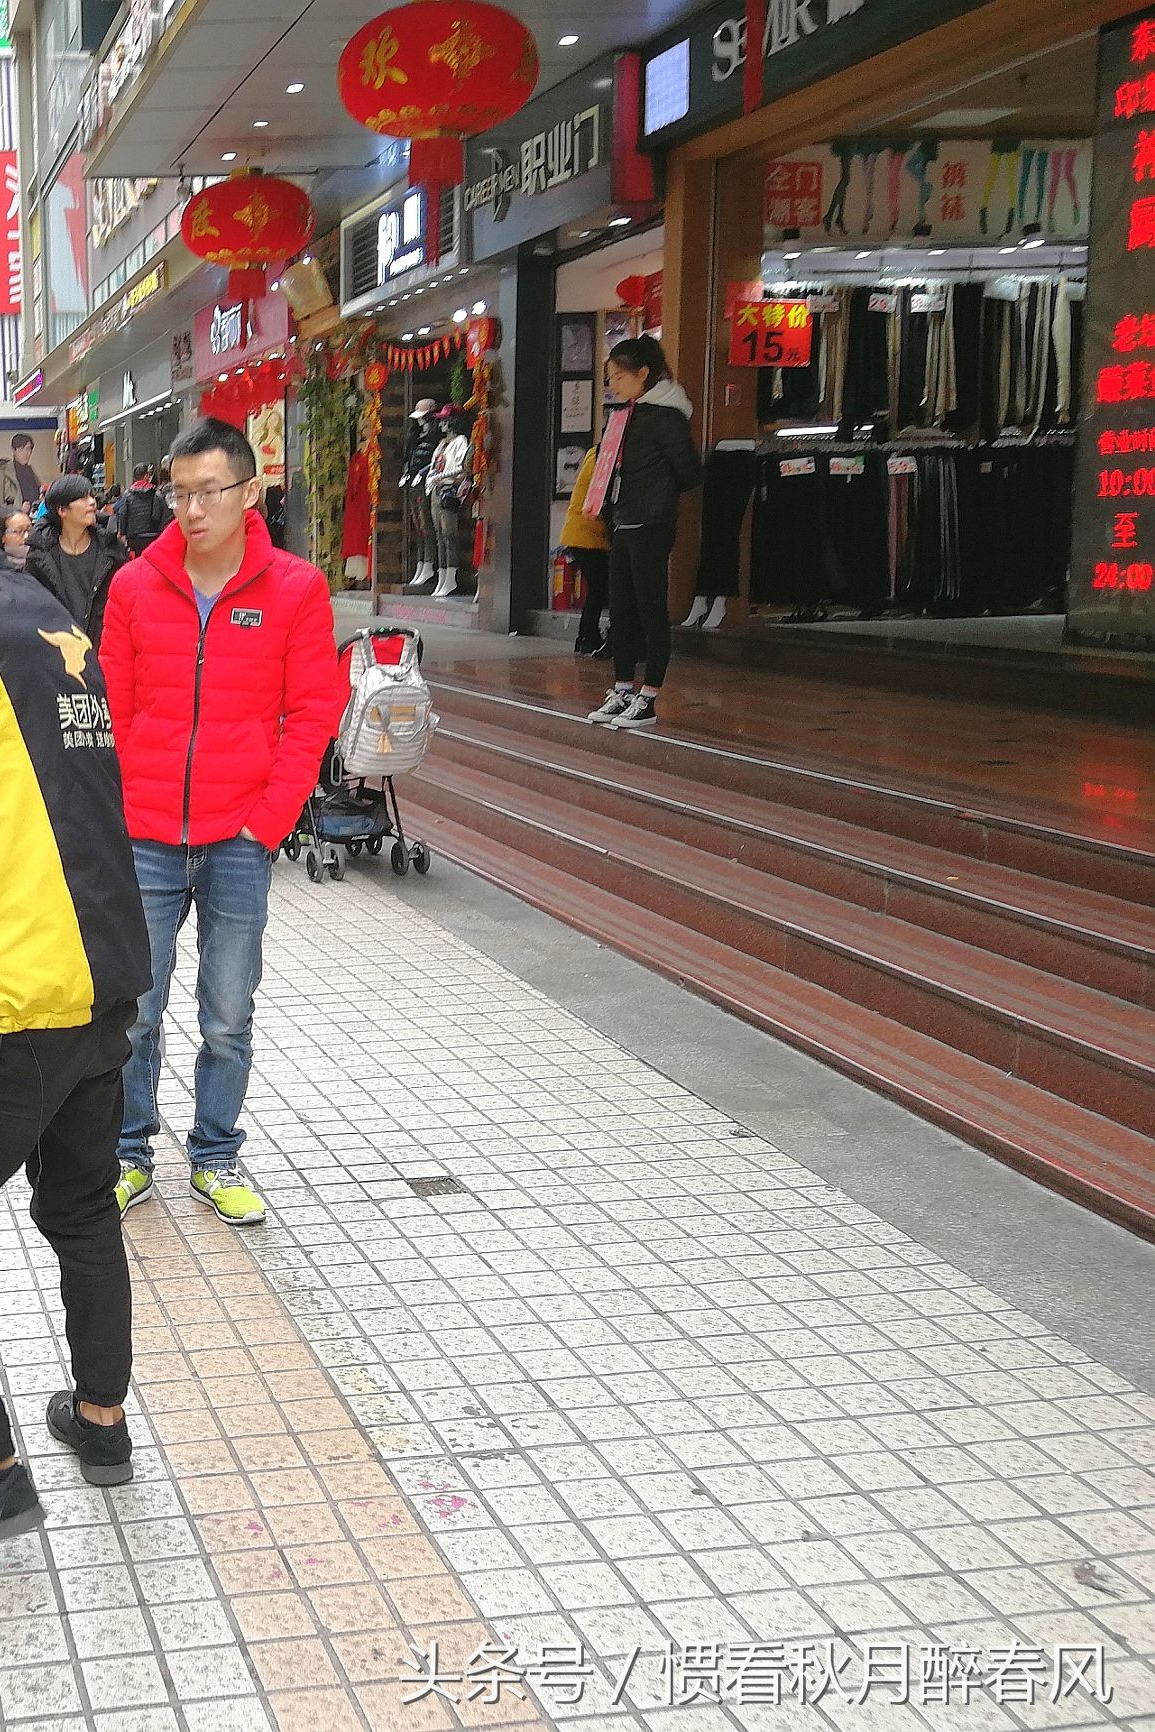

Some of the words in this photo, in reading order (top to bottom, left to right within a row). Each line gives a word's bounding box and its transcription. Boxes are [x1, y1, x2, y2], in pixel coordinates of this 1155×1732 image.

[520, 103, 600, 197] 职业门
[736, 303, 809, 329] 大特价
[1111, 512, 1139, 547] 至
[1092, 563, 1153, 589] 24:00
